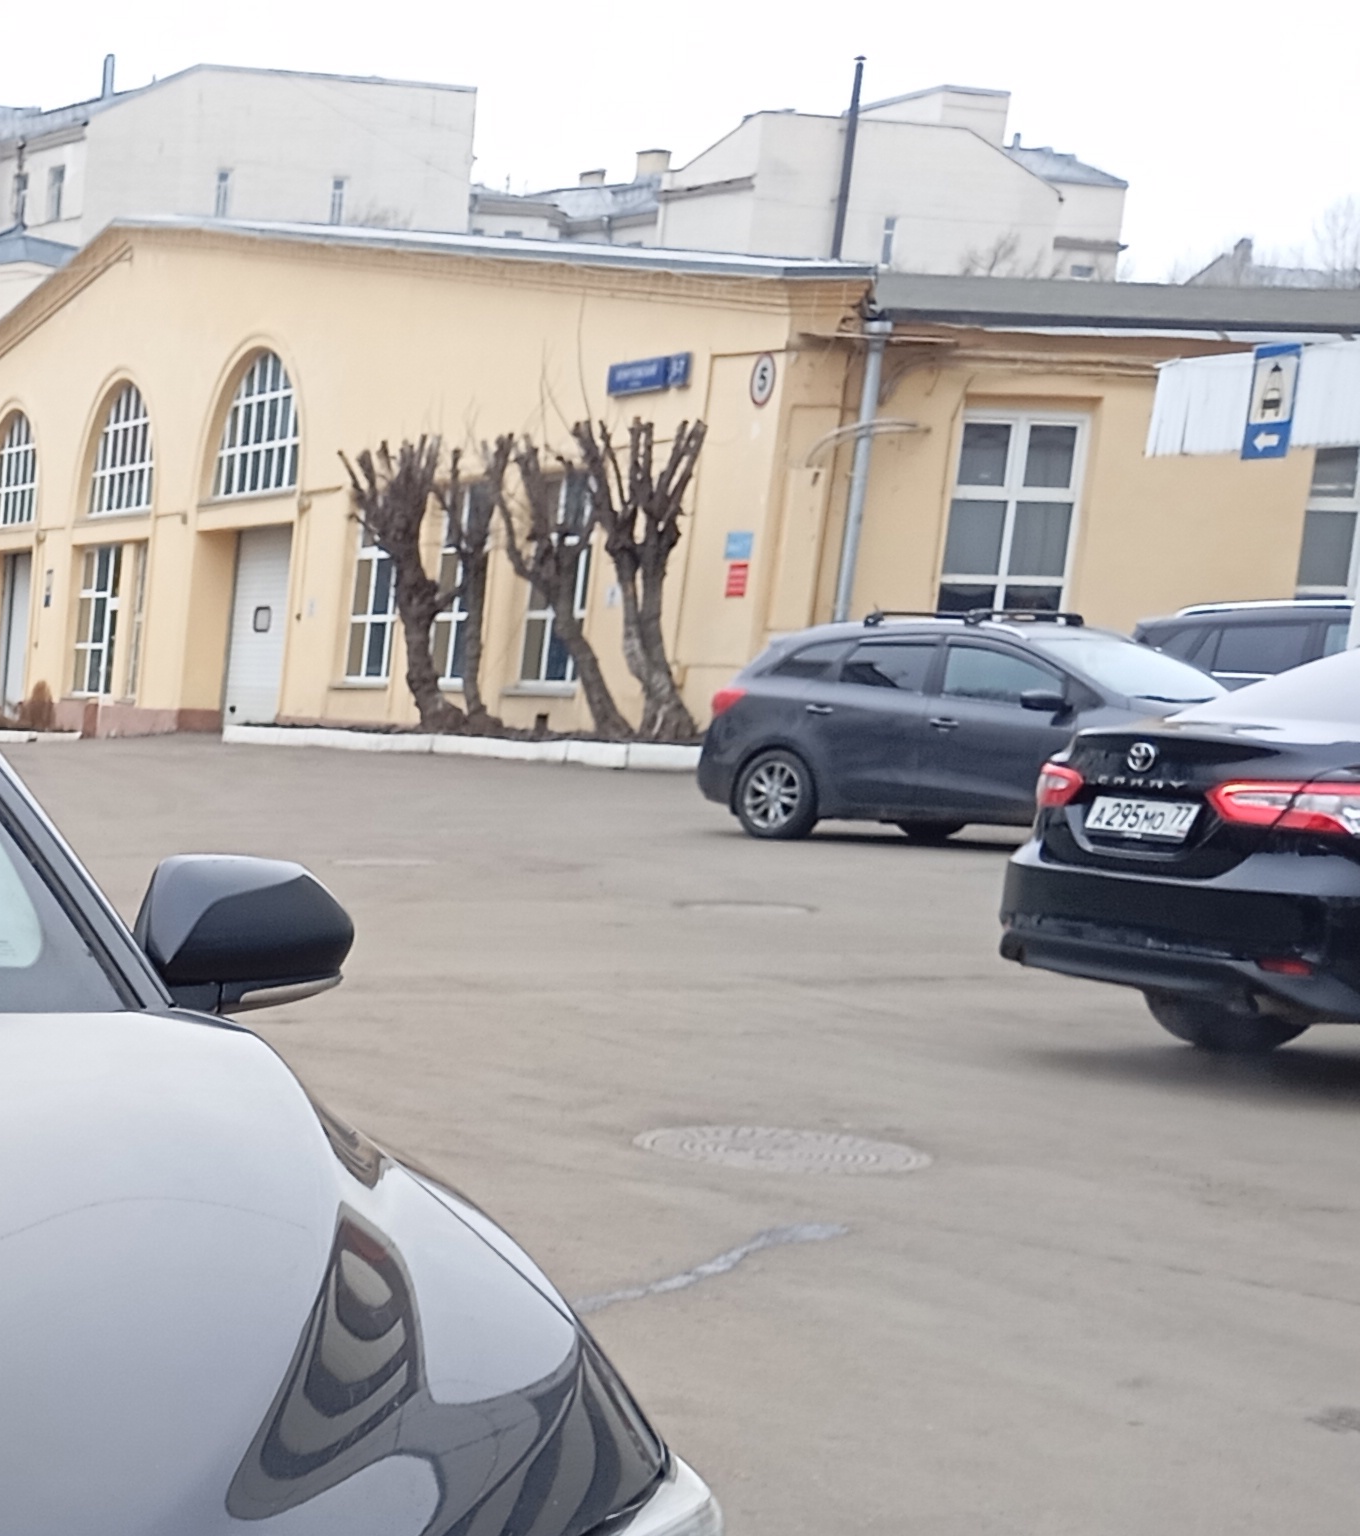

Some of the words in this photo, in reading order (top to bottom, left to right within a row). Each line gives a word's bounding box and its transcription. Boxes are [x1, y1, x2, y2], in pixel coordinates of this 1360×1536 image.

[757, 365, 769, 393] 5
[1093, 801, 1165, 831] А295МО
[1170, 805, 1193, 826] 77
